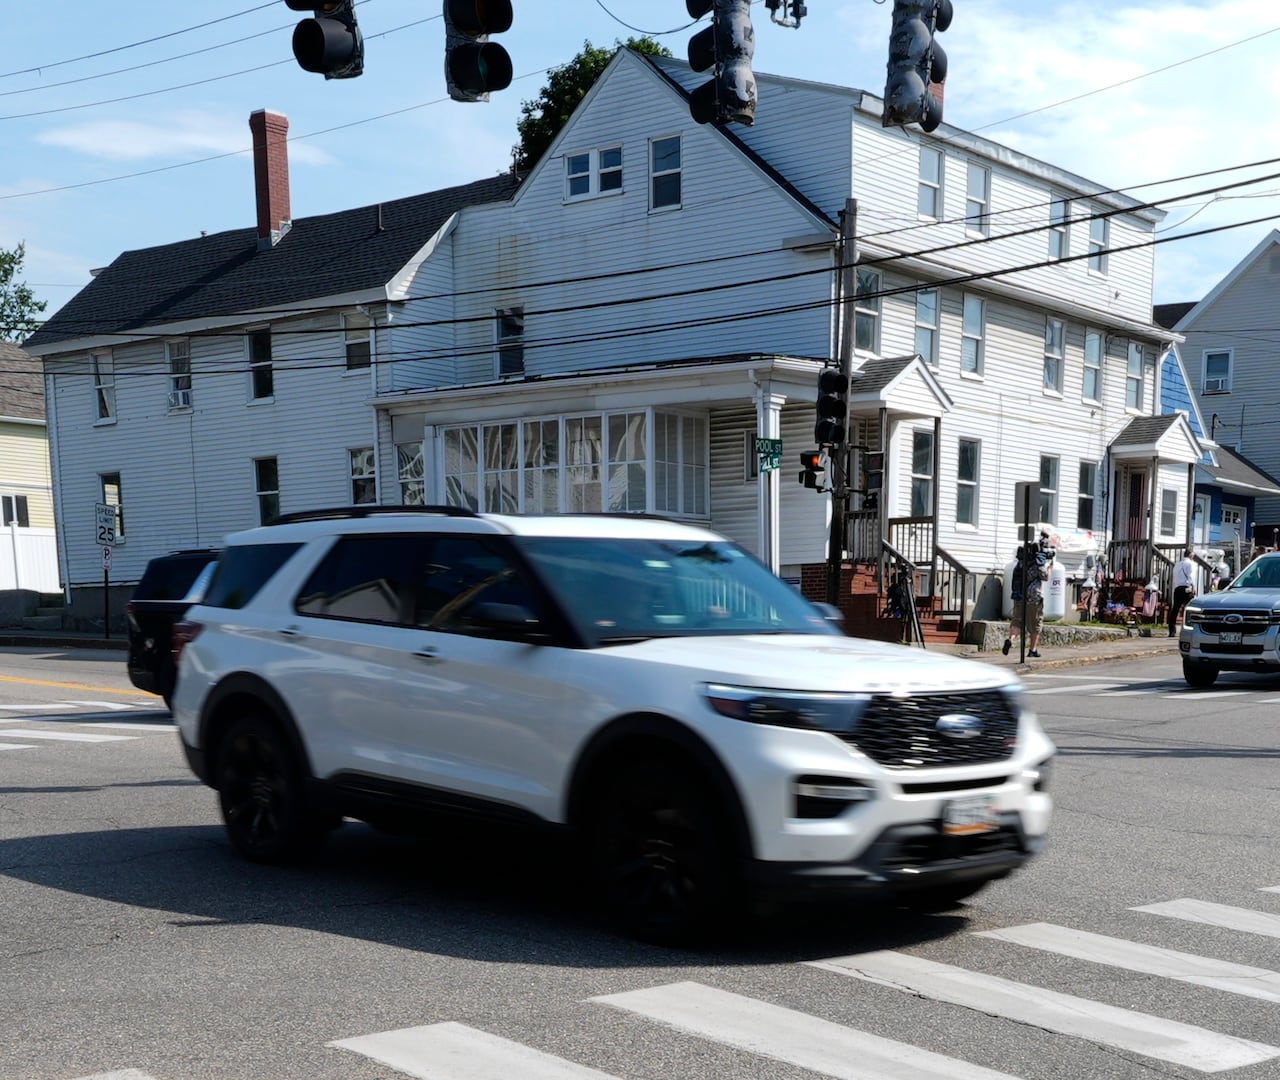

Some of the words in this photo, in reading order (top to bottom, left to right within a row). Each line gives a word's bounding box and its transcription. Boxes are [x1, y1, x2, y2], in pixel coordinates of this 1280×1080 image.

[755, 440, 773, 452] POOL
[97, 506, 114, 516] SPEED
[98, 526, 114, 542] 25
